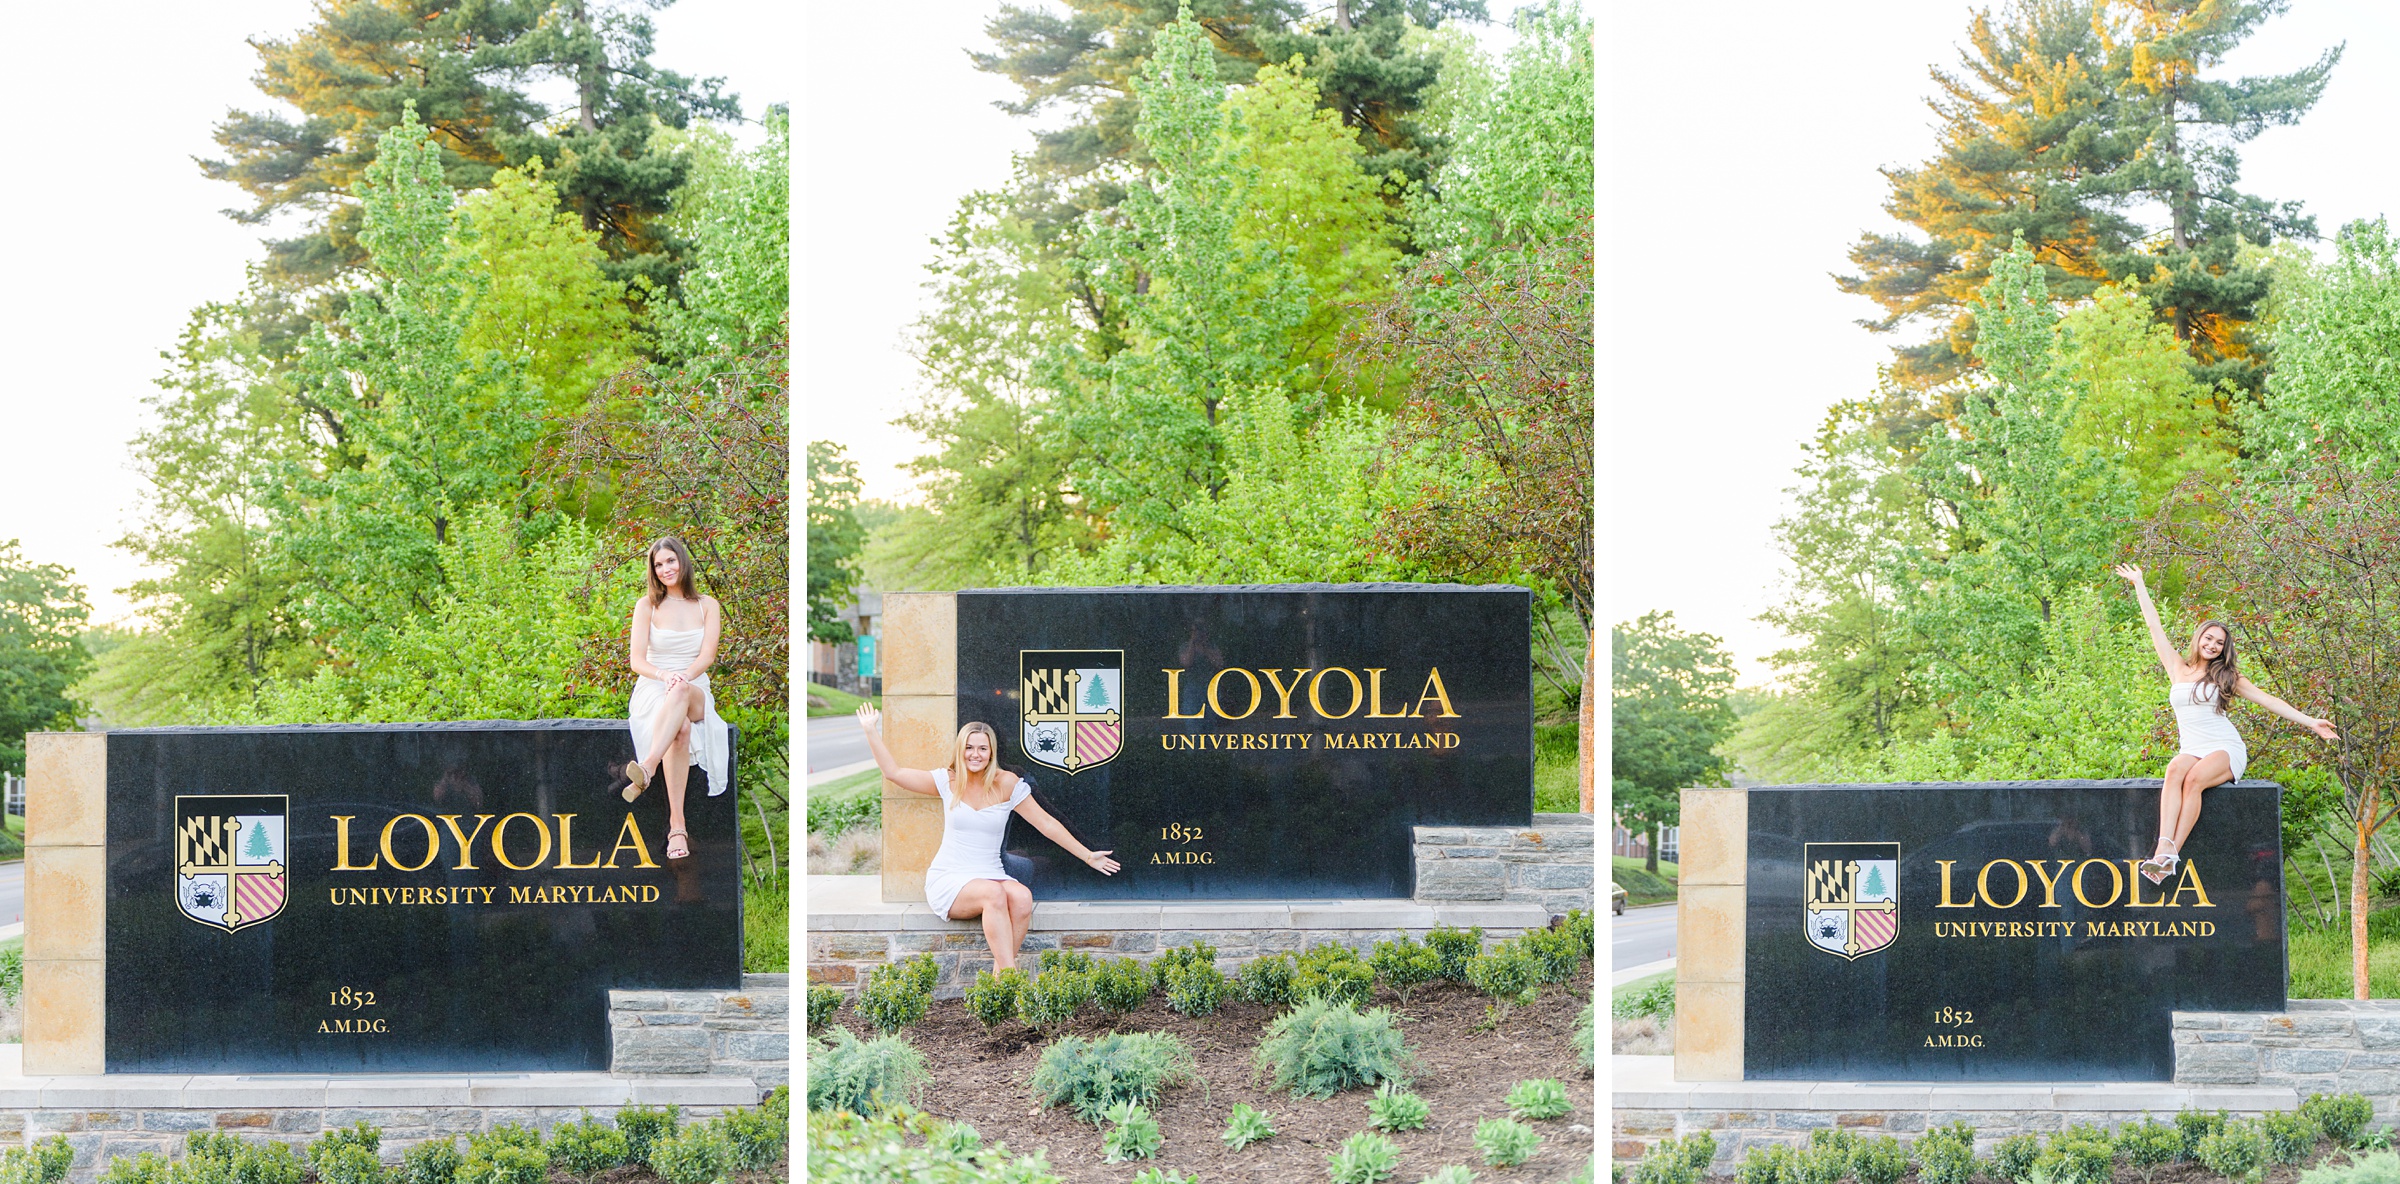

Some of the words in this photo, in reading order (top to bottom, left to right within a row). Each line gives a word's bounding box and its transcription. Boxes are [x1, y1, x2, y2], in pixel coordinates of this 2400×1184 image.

[1161, 667, 1461, 720] LOYOLA
[1161, 733, 1313, 750] UNIVERSITY
[1324, 731, 1461, 750] MARYLAND
[329, 812, 661, 871] LOYOLA
[1161, 822, 1204, 845] 1852
[1150, 852, 1216, 865] A.M.D.G.
[1935, 858, 2217, 908] LOYOLA
[330, 886, 496, 906] UNIVERSITY
[509, 884, 660, 904] MARYLAND
[1935, 921, 2076, 937] UNIVERSITY
[2087, 920, 2216, 937] MARYLAND
[330, 986, 376, 1011] 1852
[318, 1019, 390, 1033] A.M.D.G.
[1934, 1006, 1974, 1028] 1852
[1924, 1034, 1986, 1048] A.M.D.G.
